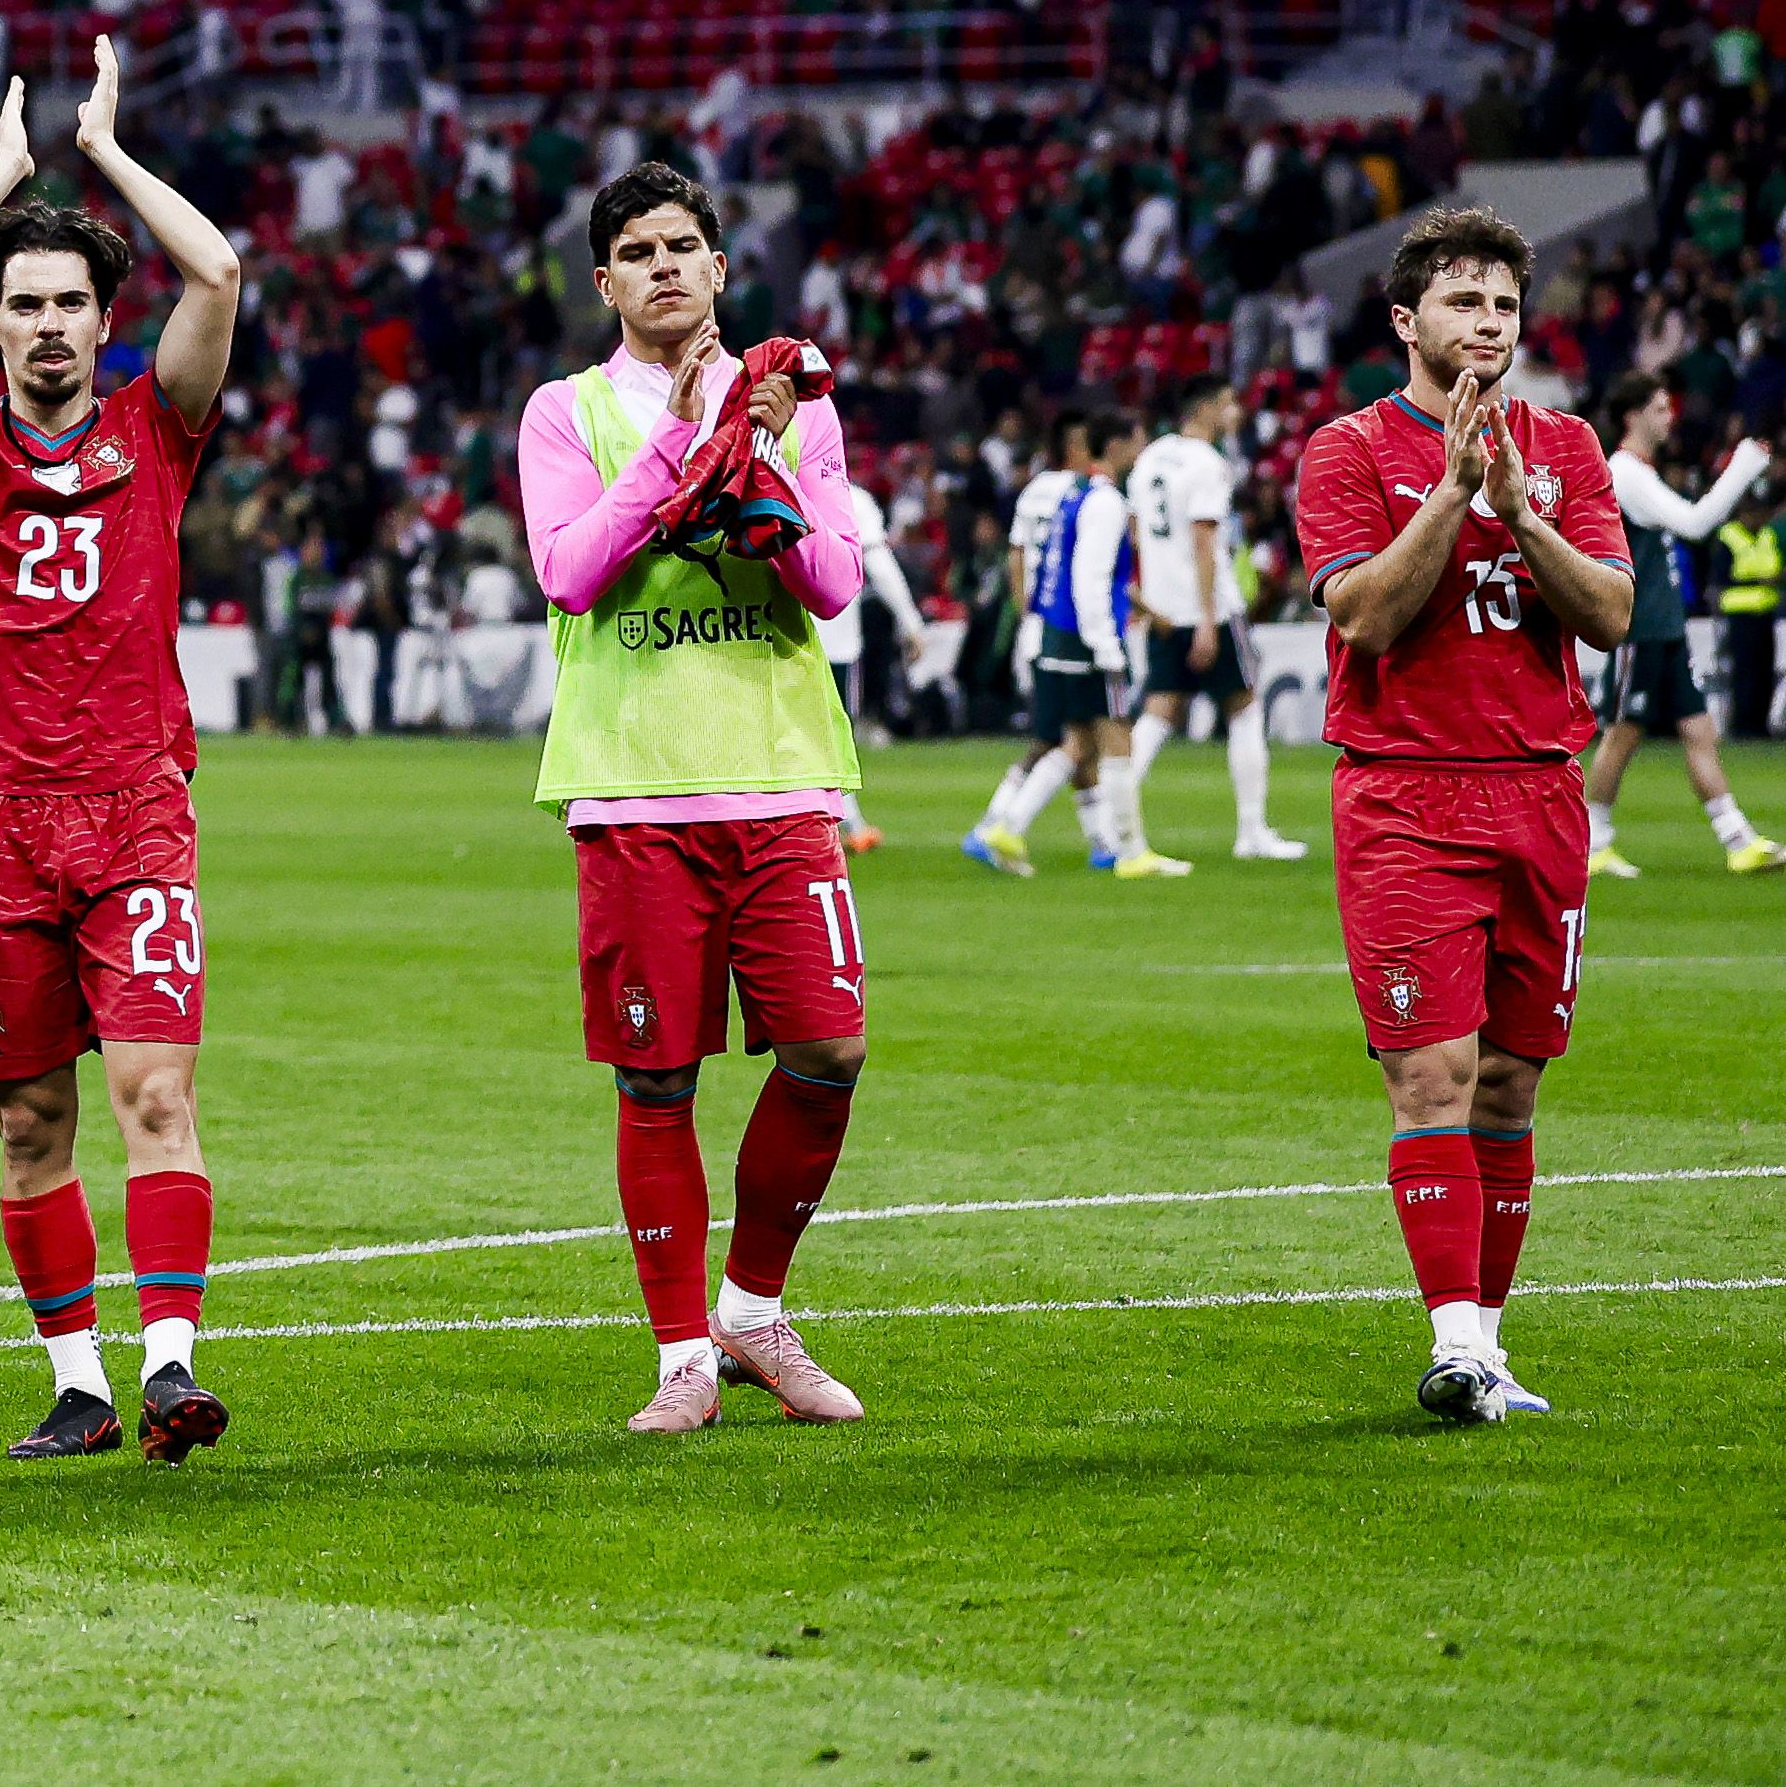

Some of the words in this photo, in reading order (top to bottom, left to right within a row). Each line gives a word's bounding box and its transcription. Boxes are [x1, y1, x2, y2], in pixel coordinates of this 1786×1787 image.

[15, 515, 104, 602] 23
[1465, 552, 1522, 634] 15
[126, 886, 201, 975] 23
[807, 878, 864, 967] 11
